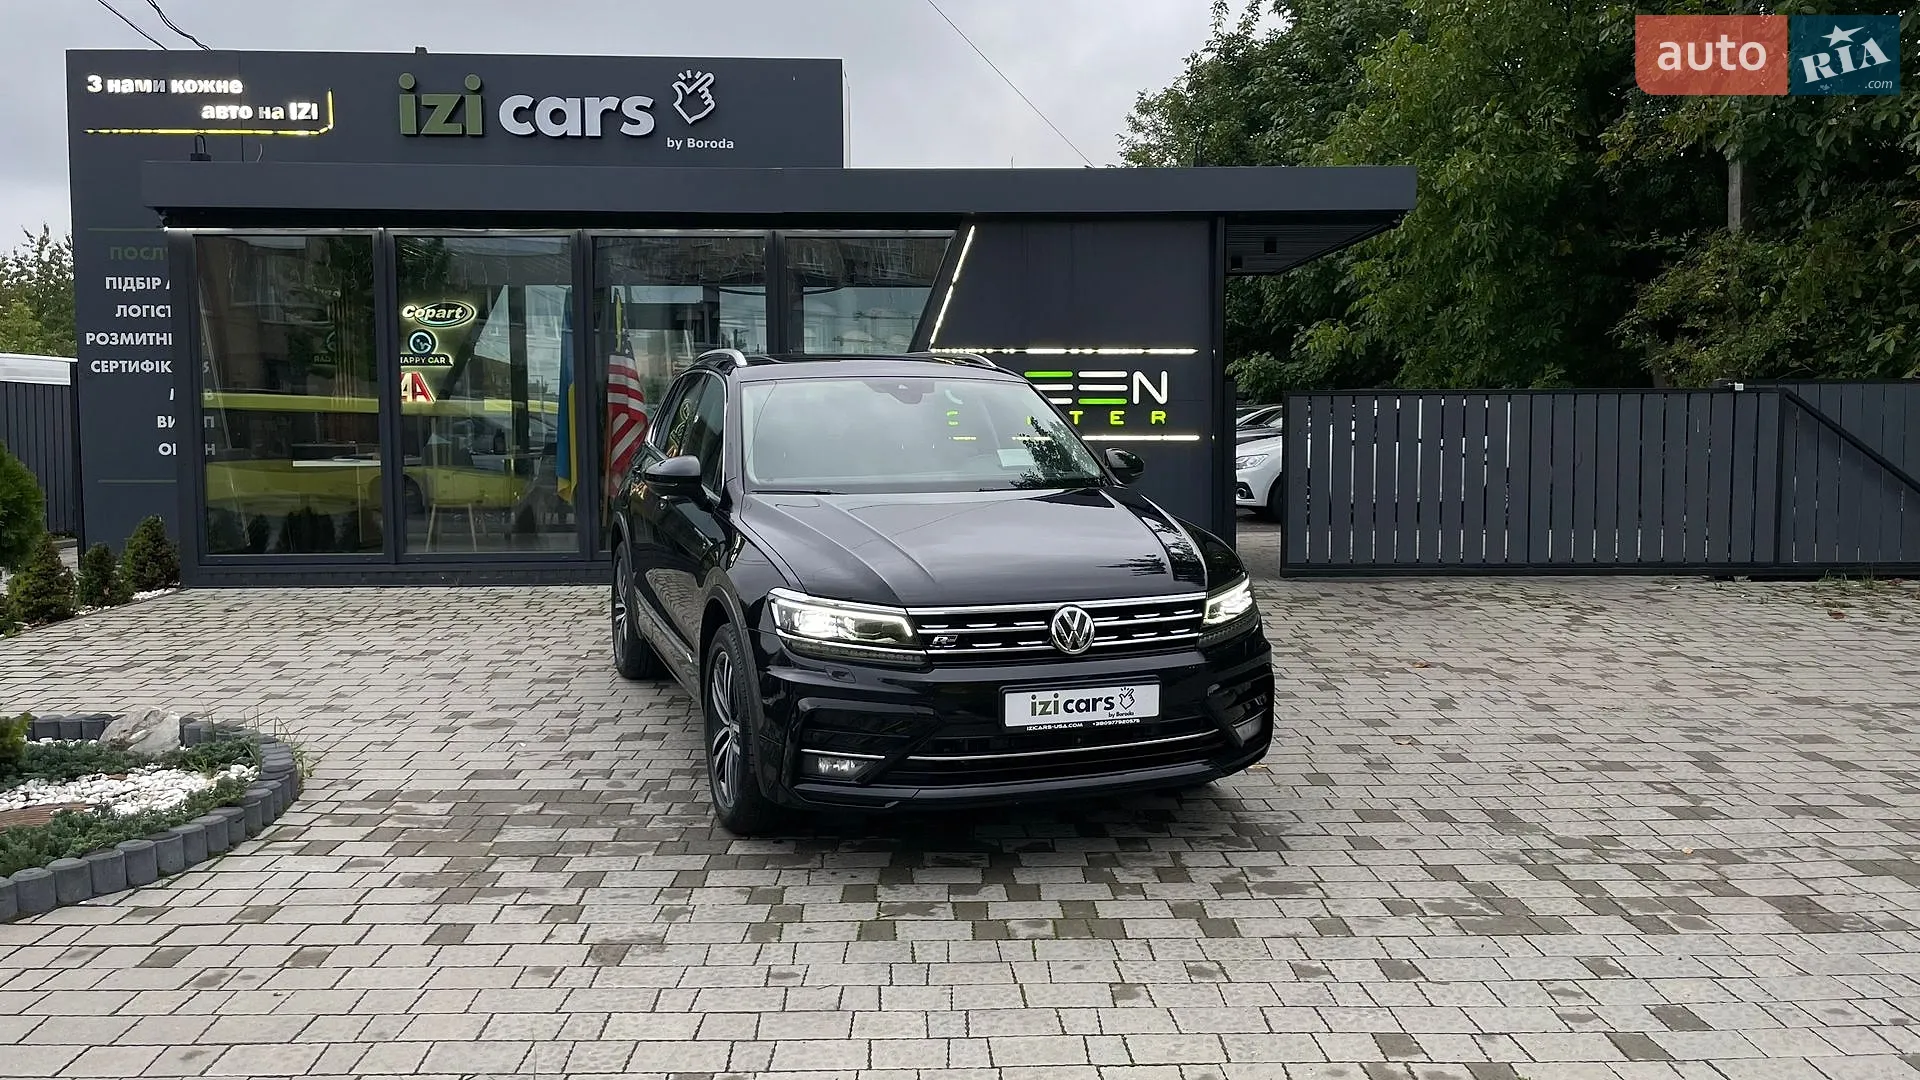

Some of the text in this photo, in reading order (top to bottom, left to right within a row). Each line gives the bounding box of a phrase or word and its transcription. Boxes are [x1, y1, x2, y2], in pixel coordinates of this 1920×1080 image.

[107, 78, 166, 94] нами
[171, 78, 244, 94] кожне
[201, 102, 319, 121] авто на IZI
[399, 73, 656, 138] izi cars
[666, 137, 735, 150] by Boroda
[110, 246, 168, 261] ПОСЛ
[105, 276, 162, 292] ПІДБІР
[402, 304, 464, 321] Copart
[428, 356, 446, 364] CAR
[1031, 693, 1115, 717] izi cars
